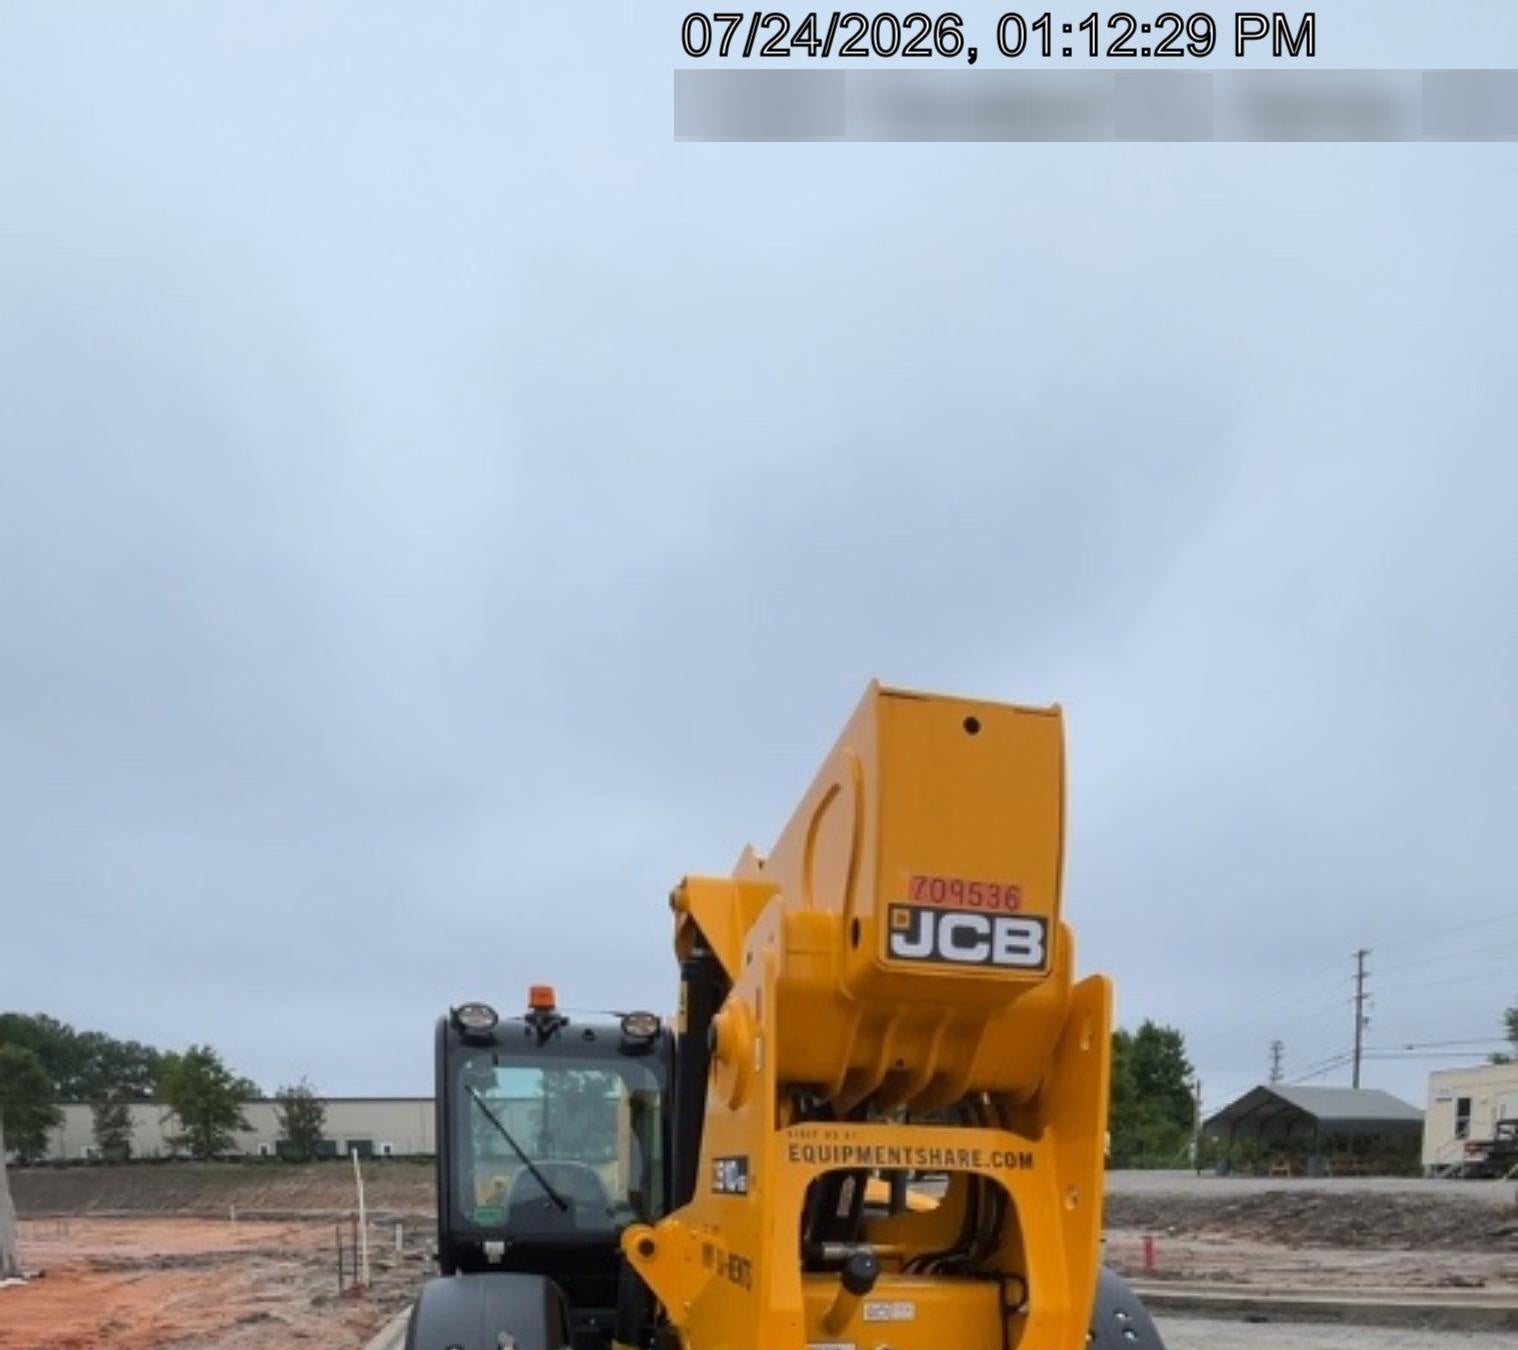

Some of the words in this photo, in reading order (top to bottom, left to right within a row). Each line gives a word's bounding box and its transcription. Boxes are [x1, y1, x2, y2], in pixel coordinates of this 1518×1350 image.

[912, 875, 1021, 911] 709536
[890, 910, 1045, 967] JCB
[787, 1144, 1034, 1170] EQUIPMENTSHARE.COM
